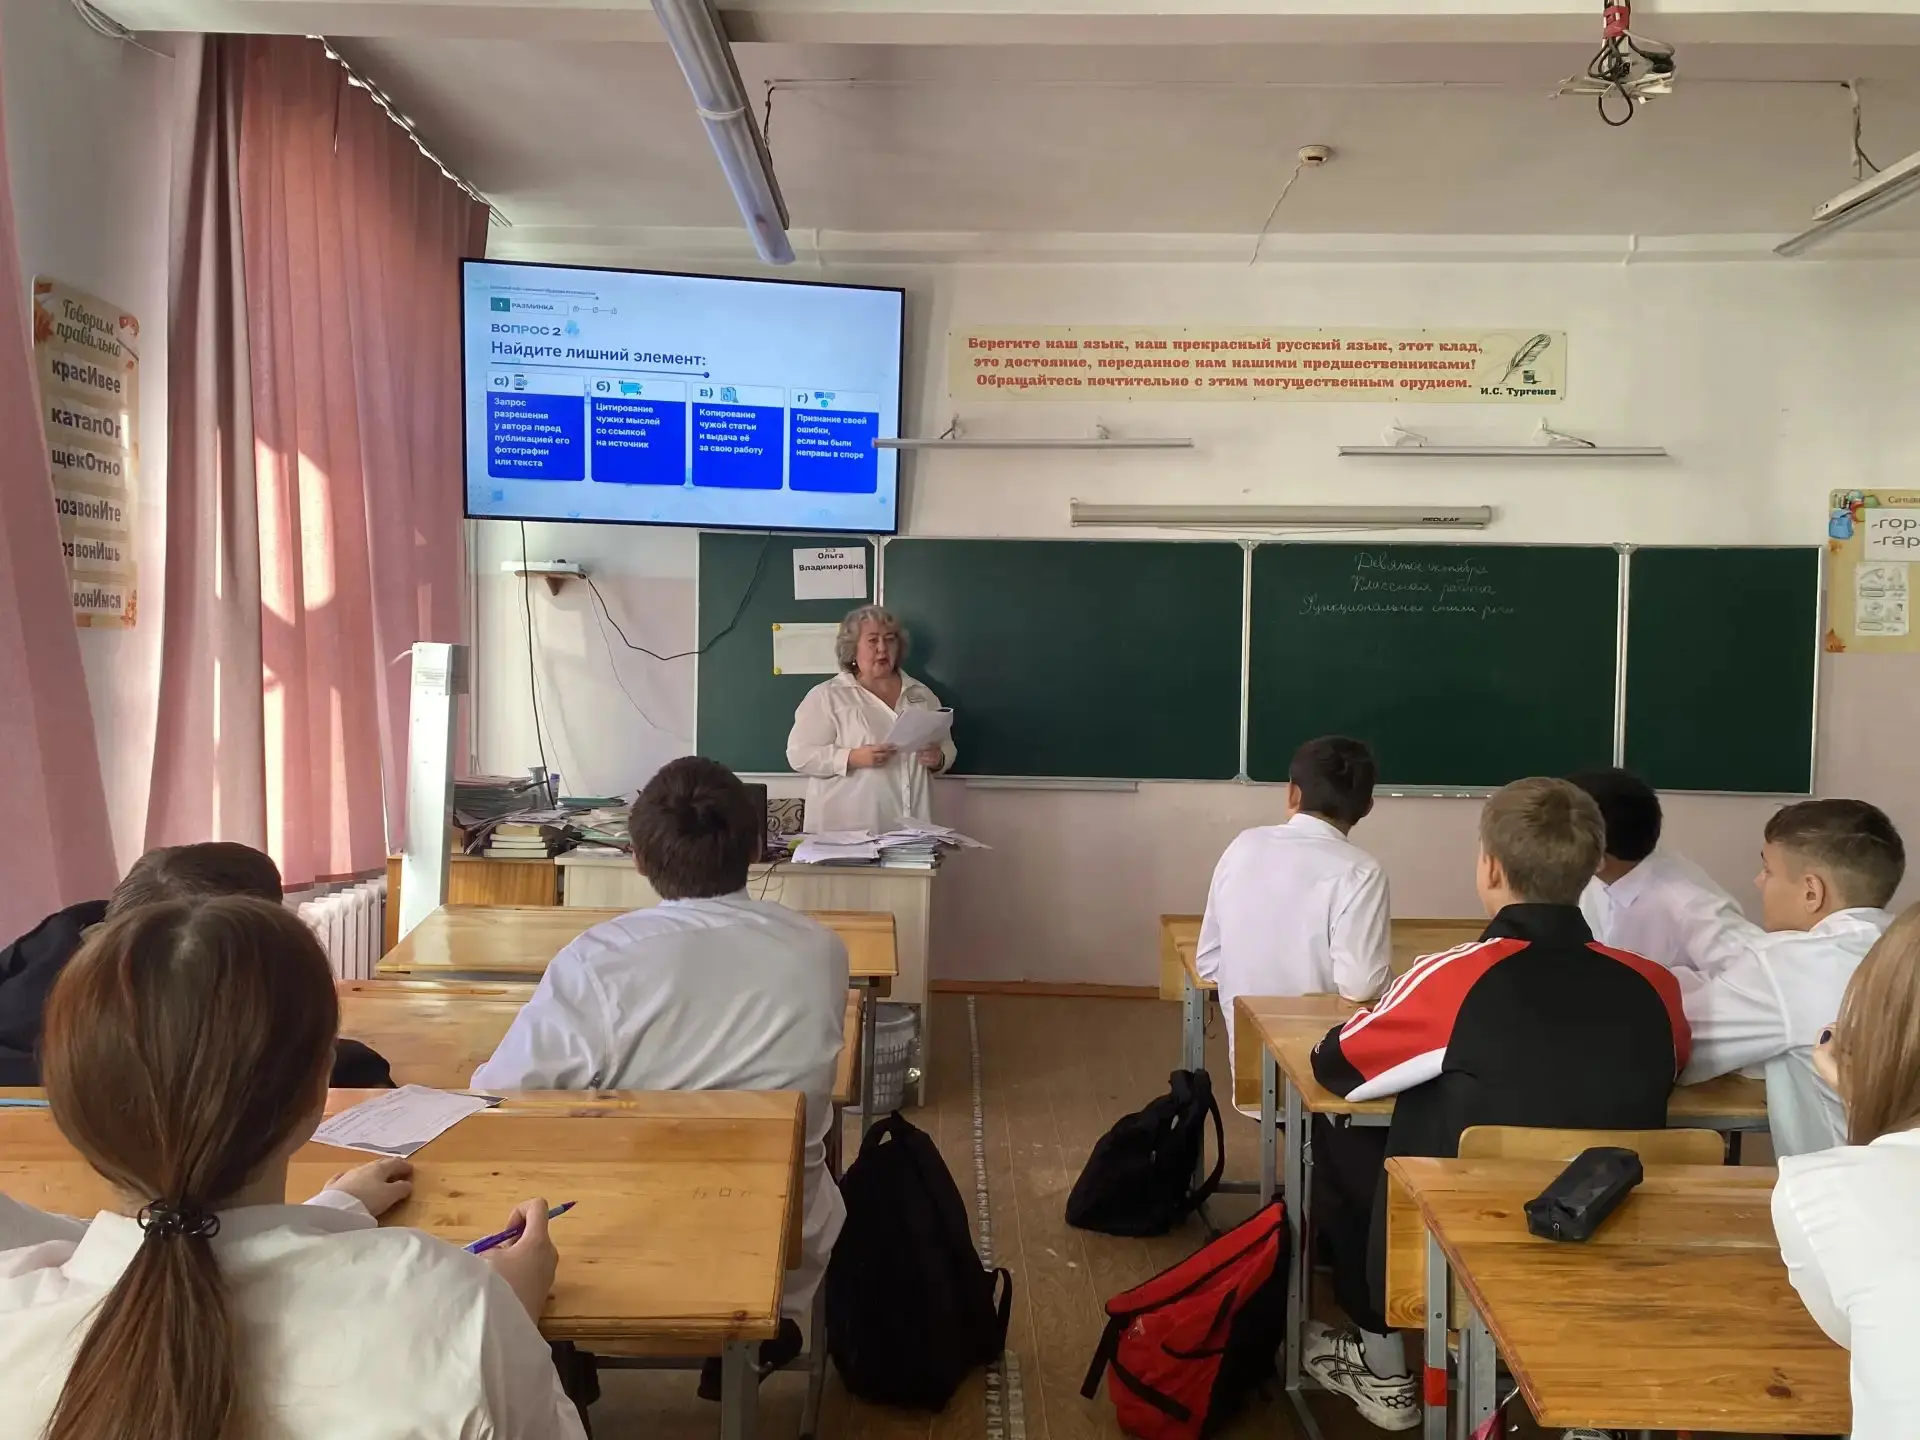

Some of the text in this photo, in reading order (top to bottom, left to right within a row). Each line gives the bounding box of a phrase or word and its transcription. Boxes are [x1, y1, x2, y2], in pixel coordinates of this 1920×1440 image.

[512, 302, 554, 311] РАЗМИНКА
[62, 299, 114, 336] Говорим
[491, 323, 561, 336] ВОПРОС 2
[56, 322, 121, 357] правильно
[968, 338, 1483, 354] Берегите наш язык, наш прекрасный русский язык, этот клад,
[491, 341, 707, 366] Найдите лишний элемент:
[974, 358, 1476, 371] это достояние, переданное нам нашими предшественниками!
[52, 359, 121, 393] красИвее
[596, 381, 611, 393] б)
[976, 374, 1472, 390] Обращайтесь почтительно с этим могущественным орудием.
[699, 388, 714, 399] в)
[1480, 387, 1556, 398] И.С. Тургенев
[494, 398, 526, 408] Запрос
[797, 393, 808, 404] г)
[596, 403, 654, 414] Цитирование
[700, 408, 756, 420] Копирование
[494, 410, 549, 420] разрешения
[796, 414, 868, 425] Признание своей
[51, 407, 121, 438] каталОг
[596, 416, 660, 426] чужих мыслей
[700, 420, 757, 431] чужой статьи
[534, 425, 562, 434] перед
[608, 428, 646, 437] ссылкой
[796, 426, 831, 436] ошибки,
[494, 434, 554, 444] публикацией
[706, 434, 738, 443] выдача
[740, 434, 750, 442] её
[796, 438, 816, 446] если
[830, 438, 852, 447] были
[608, 440, 649, 449] источник
[494, 447, 549, 457] фотографии
[734, 446, 763, 456] работу
[796, 450, 832, 459] неправы
[840, 452, 864, 460] споре
[52, 449, 120, 476] щекОтно
[798, 563, 864, 572] Владимировна
